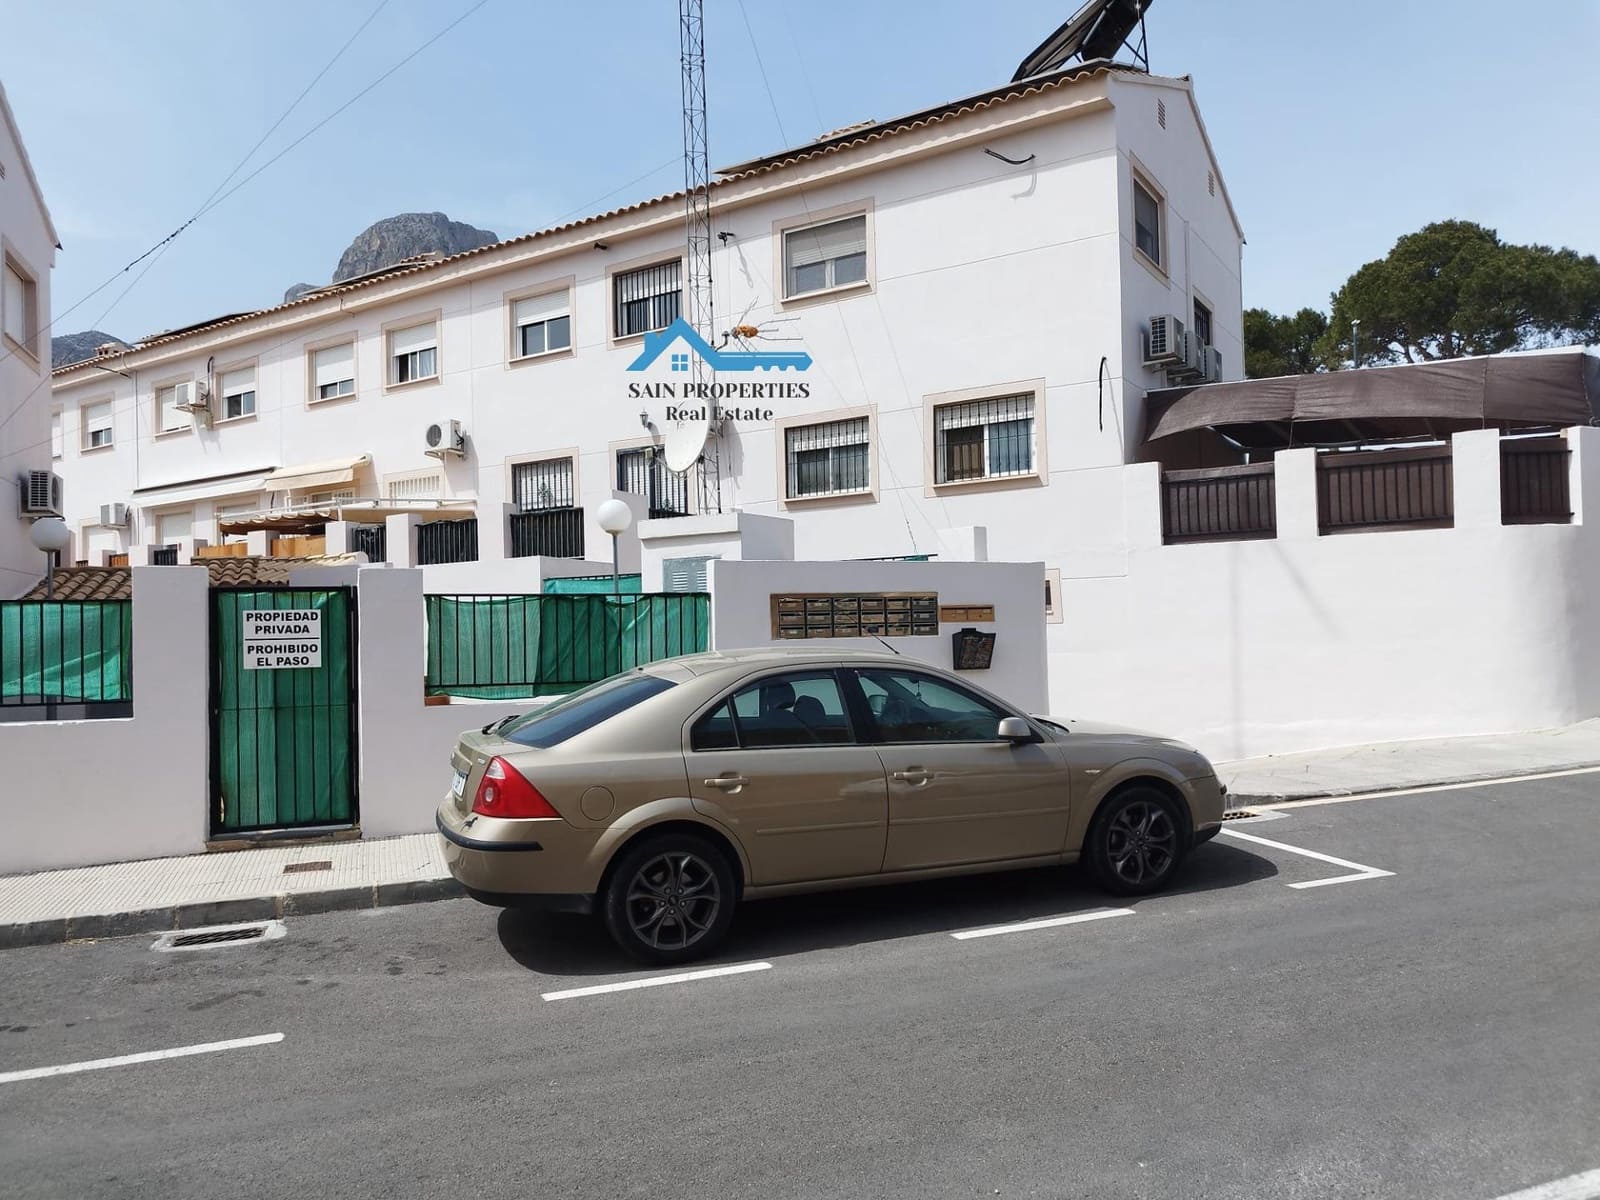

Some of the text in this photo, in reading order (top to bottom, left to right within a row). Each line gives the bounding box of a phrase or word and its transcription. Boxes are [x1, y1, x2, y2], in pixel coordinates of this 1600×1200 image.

[246, 612, 318, 622] PROPIEDAD
[255, 625, 310, 634] PRIVADA
[247, 644, 318, 654] PROHIBIDO
[257, 656, 310, 666] EL PASO
